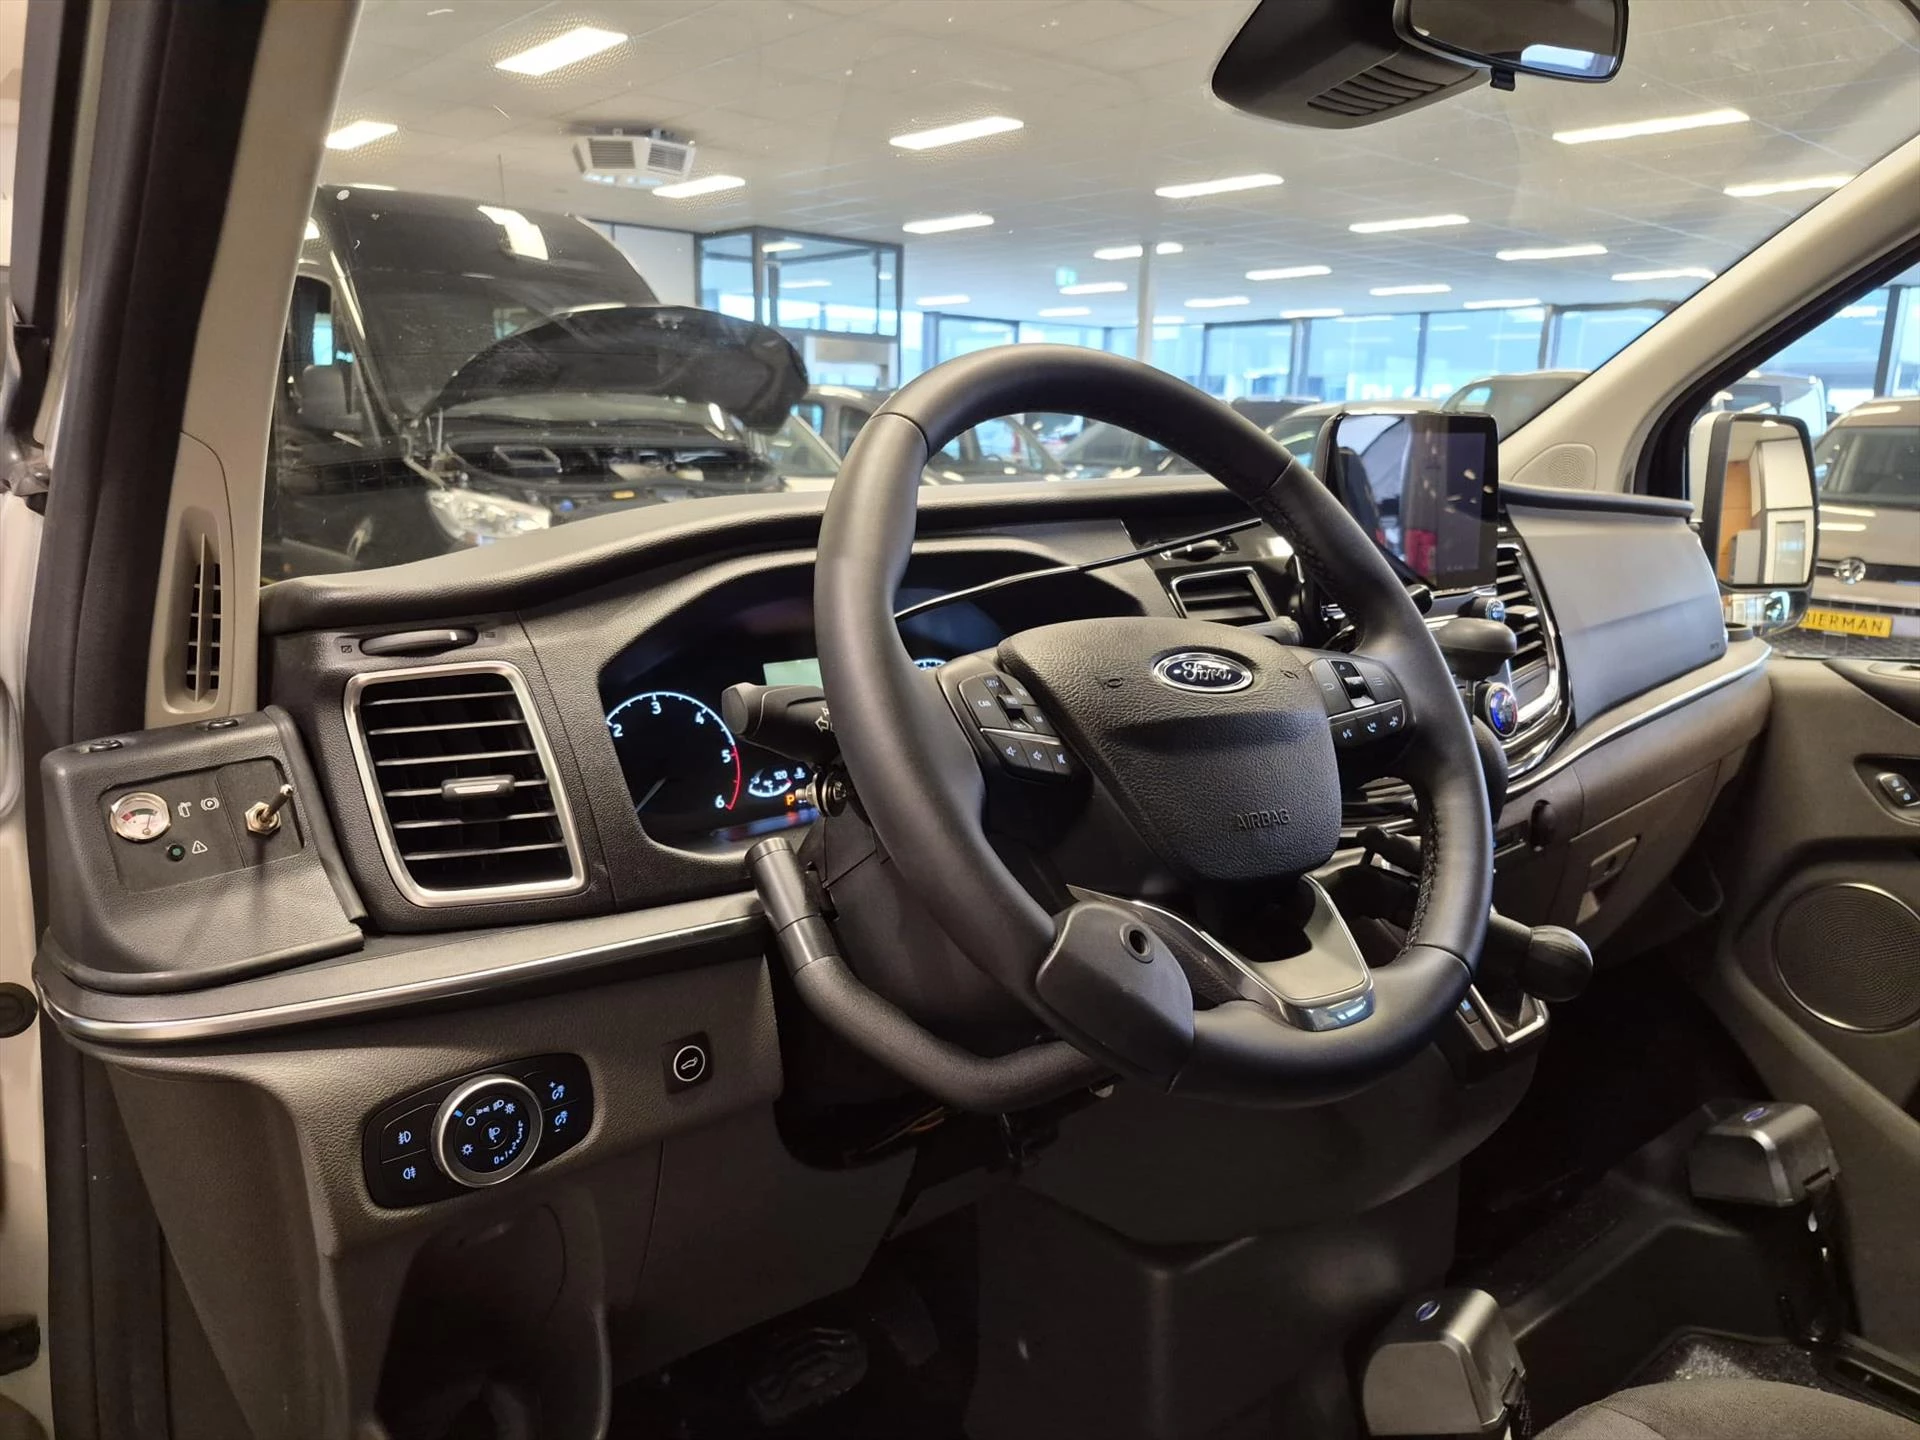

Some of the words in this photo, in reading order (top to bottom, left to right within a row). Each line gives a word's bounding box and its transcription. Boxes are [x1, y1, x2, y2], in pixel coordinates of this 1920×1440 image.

[651, 702, 661, 715] 3
[695, 712, 705, 725] 4
[613, 724, 623, 738] 2
[721, 750, 731, 764] 5
[715, 795, 725, 809] 6
[1237, 808, 1291, 829] AIRBAG
